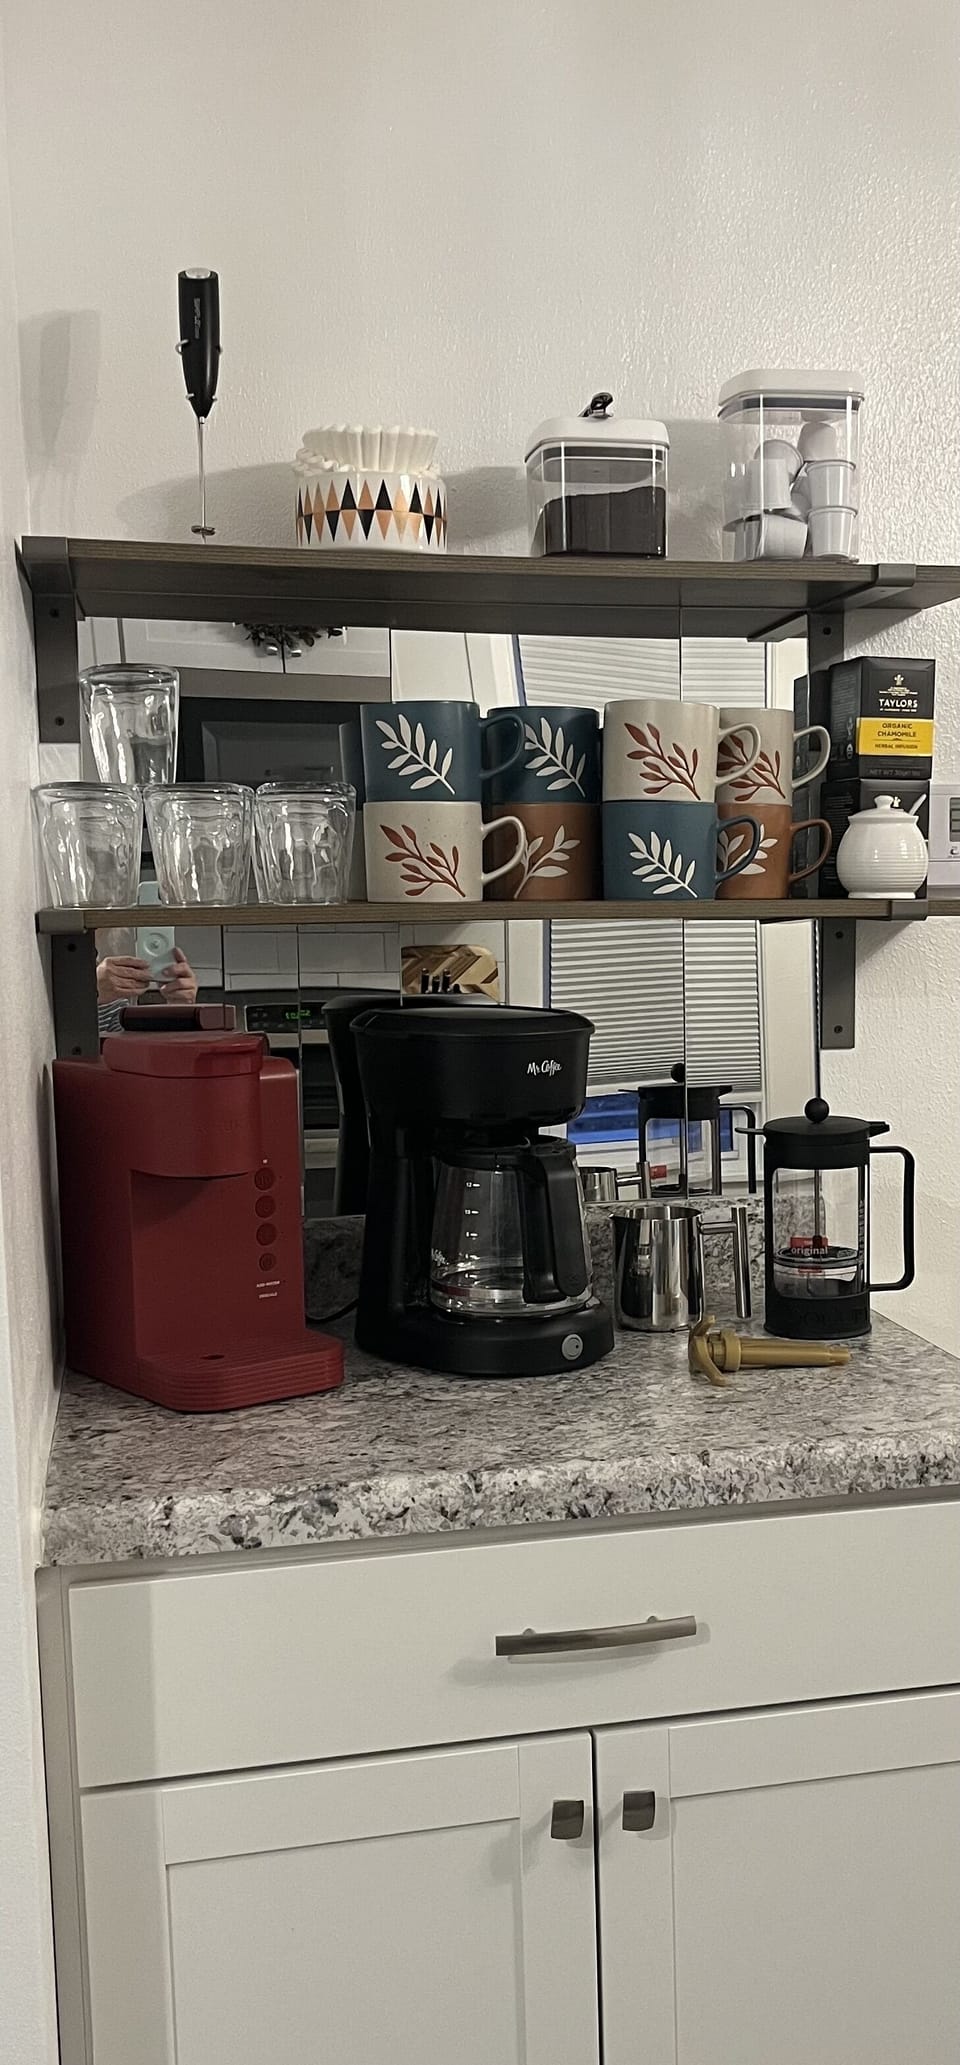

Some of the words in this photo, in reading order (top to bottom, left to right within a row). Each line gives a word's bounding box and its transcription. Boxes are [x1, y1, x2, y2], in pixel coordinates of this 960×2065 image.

[879, 699, 918, 708] TAYLORS
[882, 722, 913, 730] ORGANIC
[877, 731, 917, 739] CHAMOMILE
[541, 1060, 562, 1076] Coffee
[791, 1246, 828, 1256] original
